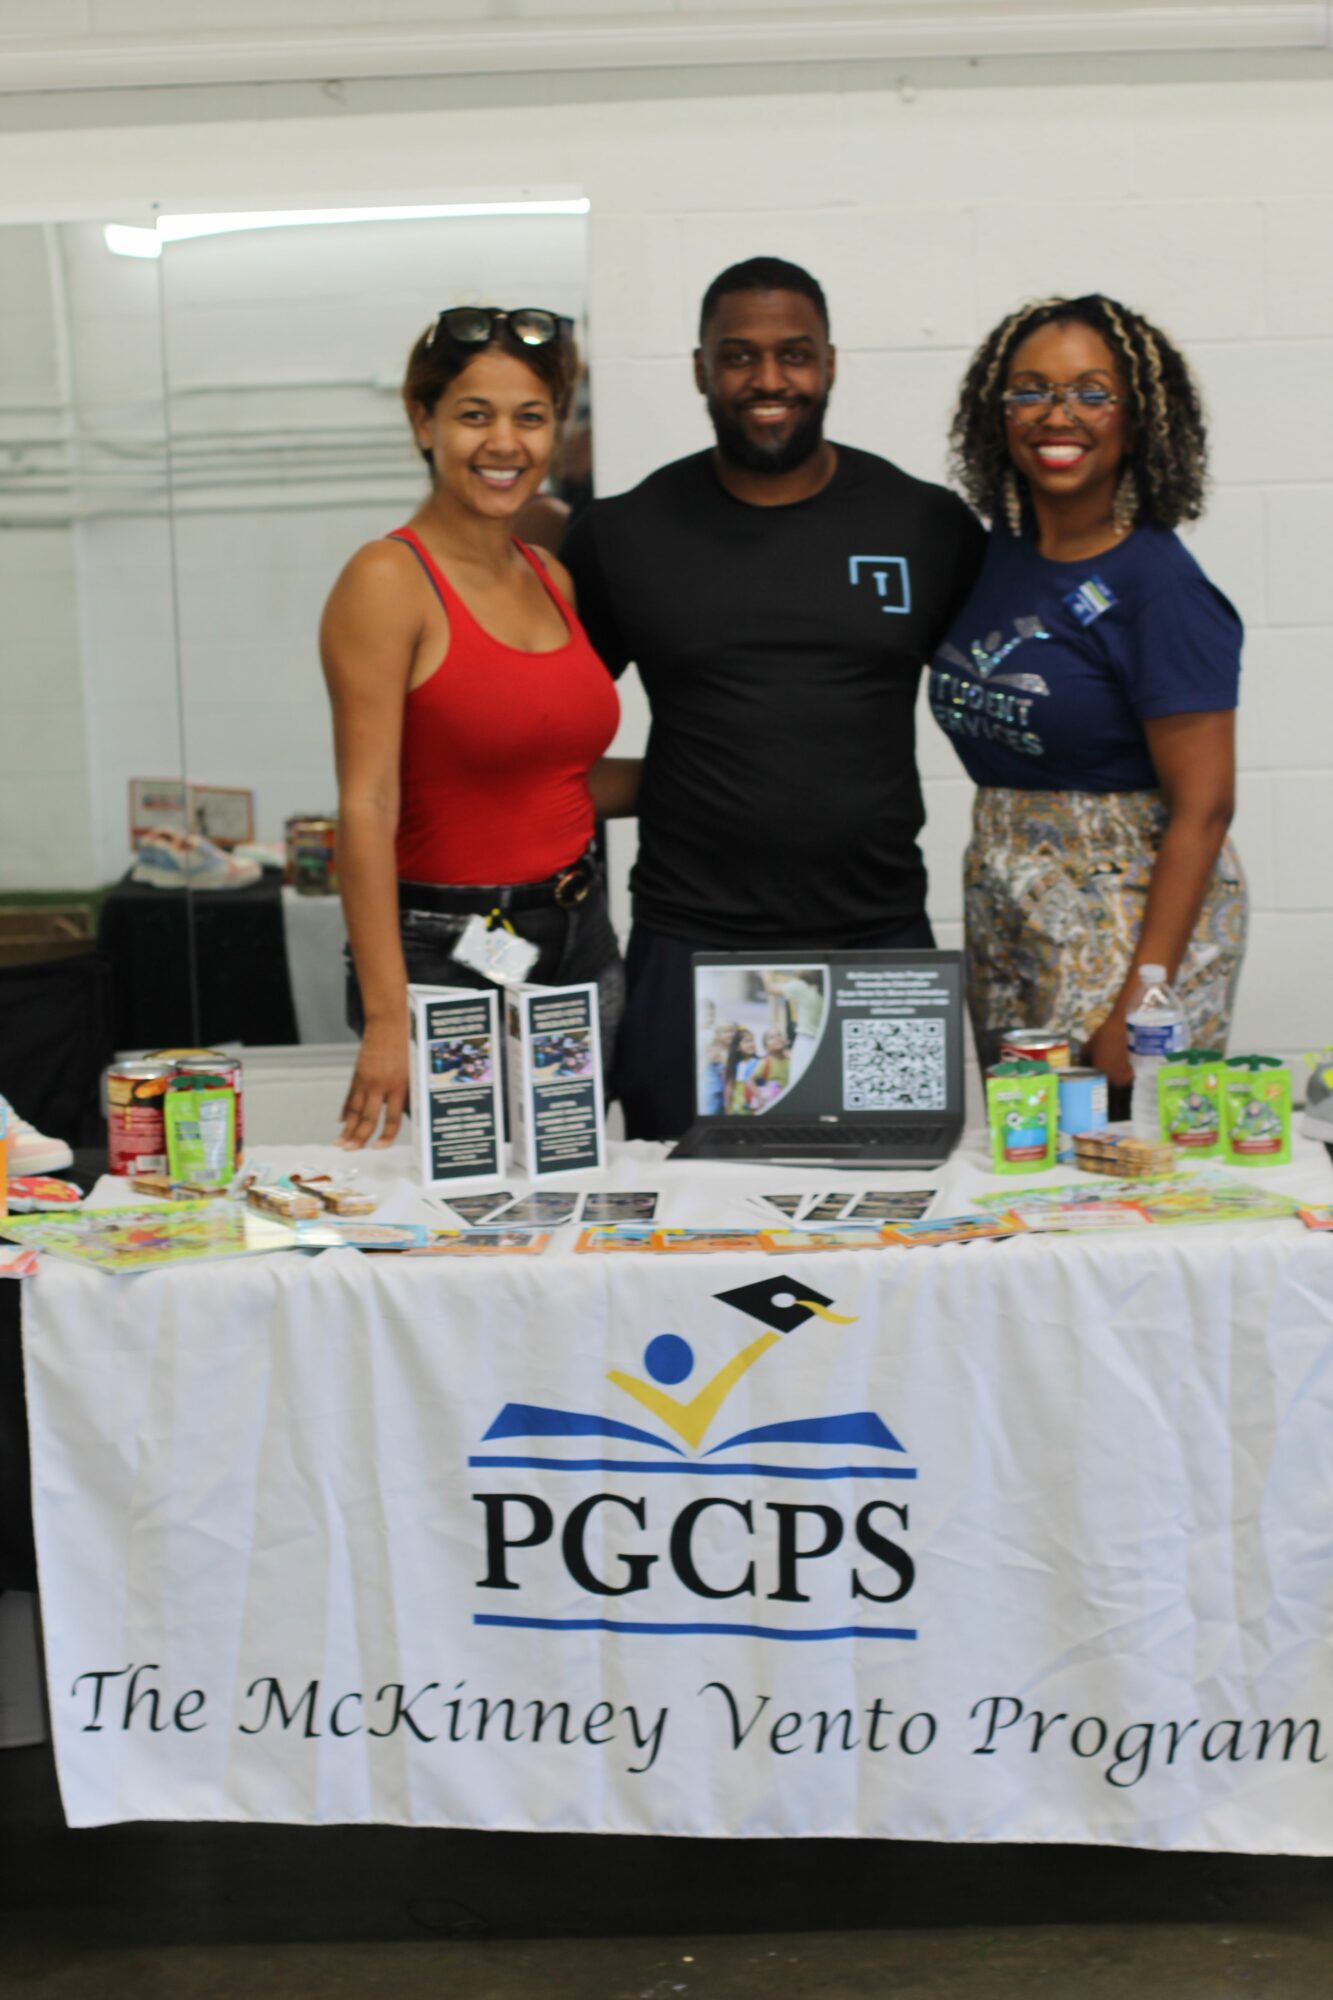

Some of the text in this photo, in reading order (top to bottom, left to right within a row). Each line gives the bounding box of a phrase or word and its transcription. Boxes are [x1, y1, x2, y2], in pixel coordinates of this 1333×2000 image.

[873, 571, 889, 597] T
[472, 1493, 915, 1603] PGCPS
[71, 1664, 1329, 1788] The McKinney Vento Program
